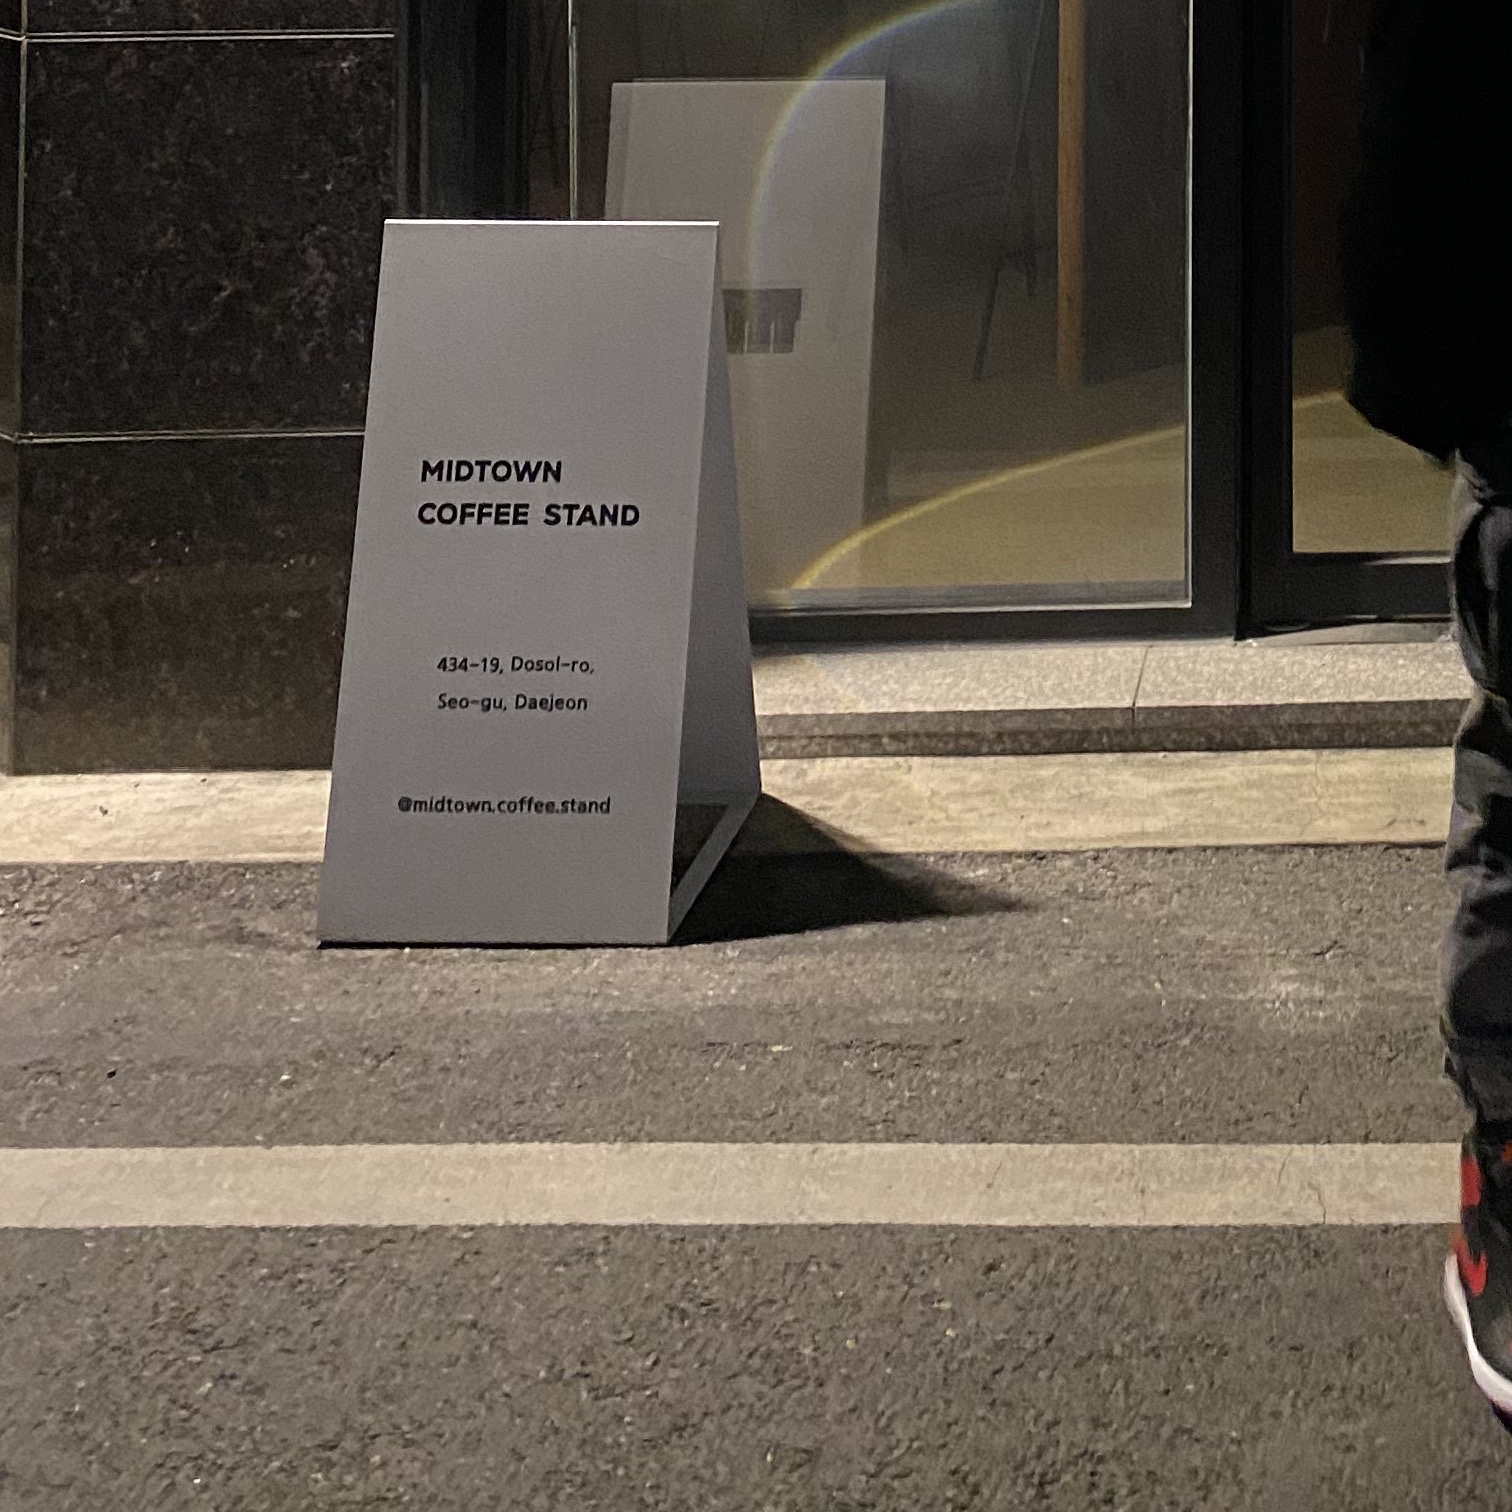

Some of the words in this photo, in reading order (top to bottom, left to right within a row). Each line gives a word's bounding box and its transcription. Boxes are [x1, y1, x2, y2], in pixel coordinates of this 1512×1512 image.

[420, 459, 562, 483] MIDTOWN
[417, 502, 530, 526] COFFEE
[543, 503, 641, 527] STAND
[437, 656, 504, 675] 434-19,
[510, 655, 595, 675] Dosol-ro,
[437, 692, 508, 713] Seo-gu,
[514, 693, 589, 713] Daejeon
[398, 795, 611, 815] @midtown.coffee.stand
